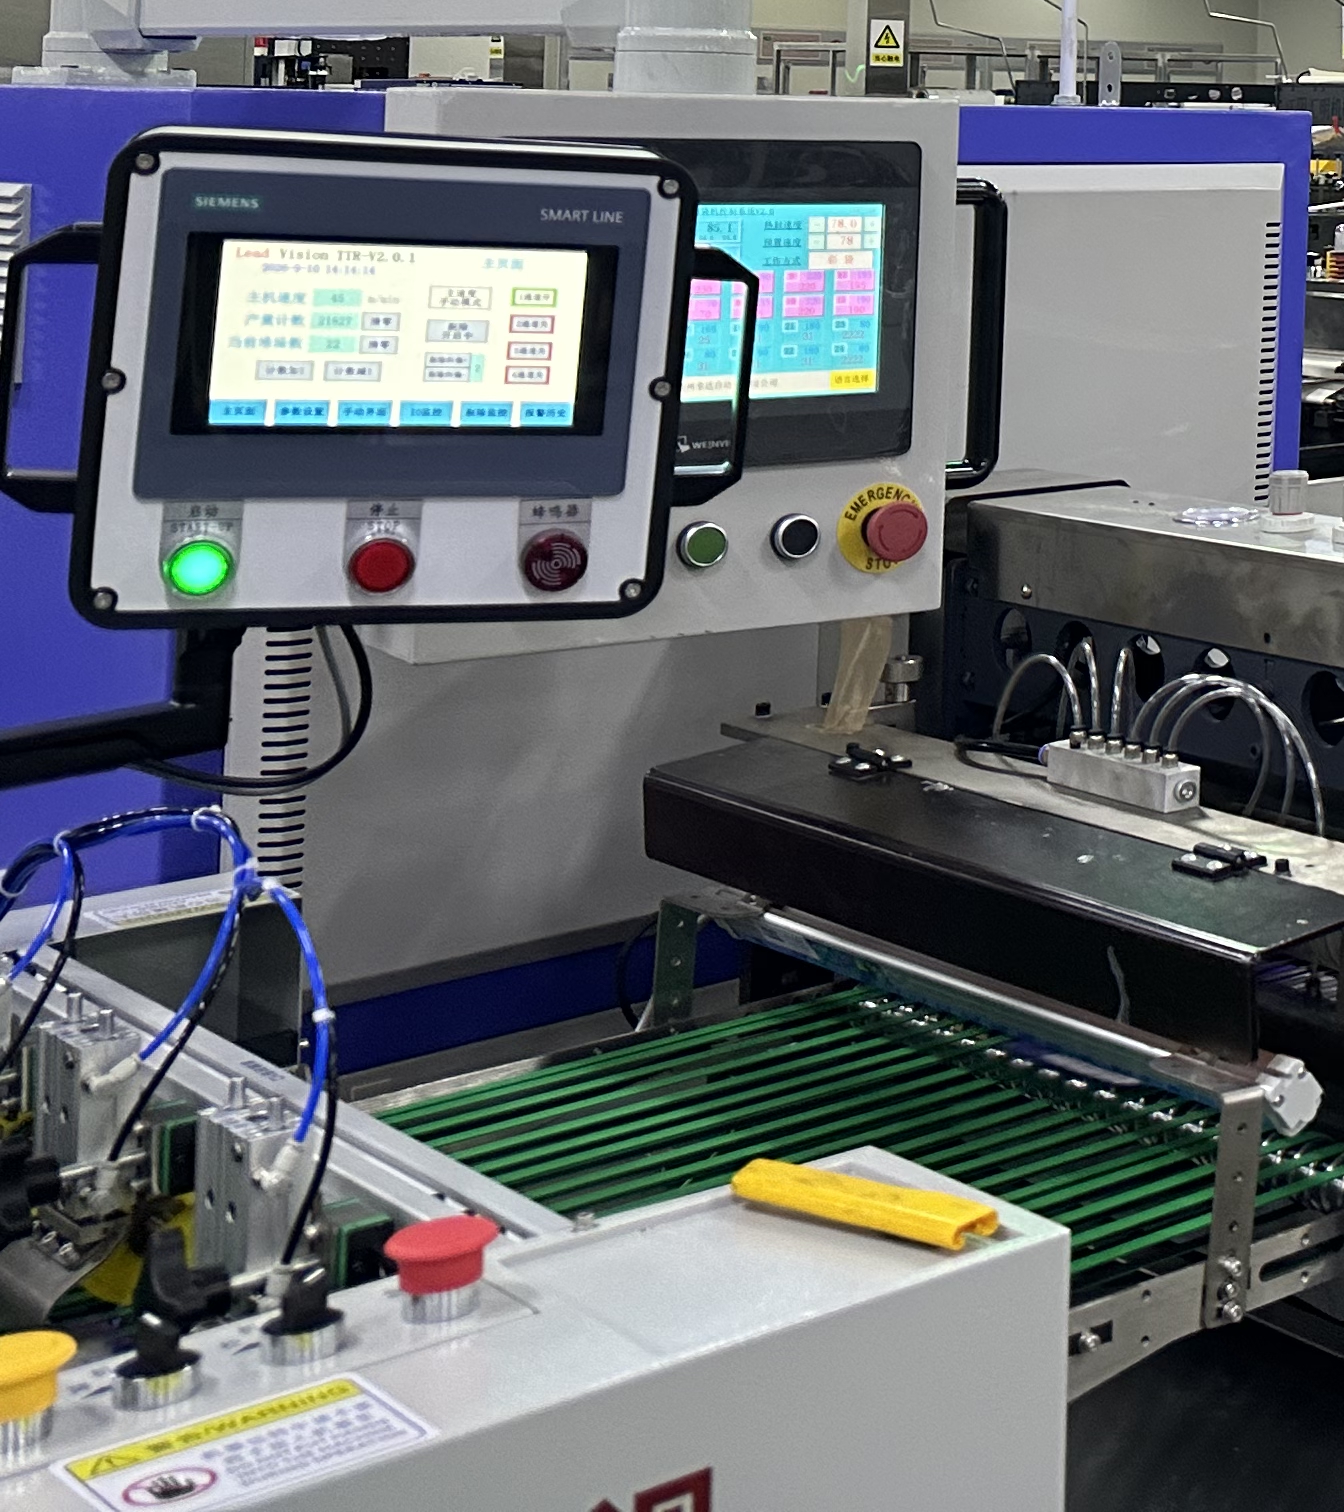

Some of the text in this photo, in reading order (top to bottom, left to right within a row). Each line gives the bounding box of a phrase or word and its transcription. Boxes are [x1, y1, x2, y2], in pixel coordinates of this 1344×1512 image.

[194, 196, 260, 209] SIEMENS
[539, 207, 624, 224] SMART LINE
[280, 248, 329, 261] Vision
[843, 486, 919, 522] EMERGENC
[865, 556, 899, 571] STO
